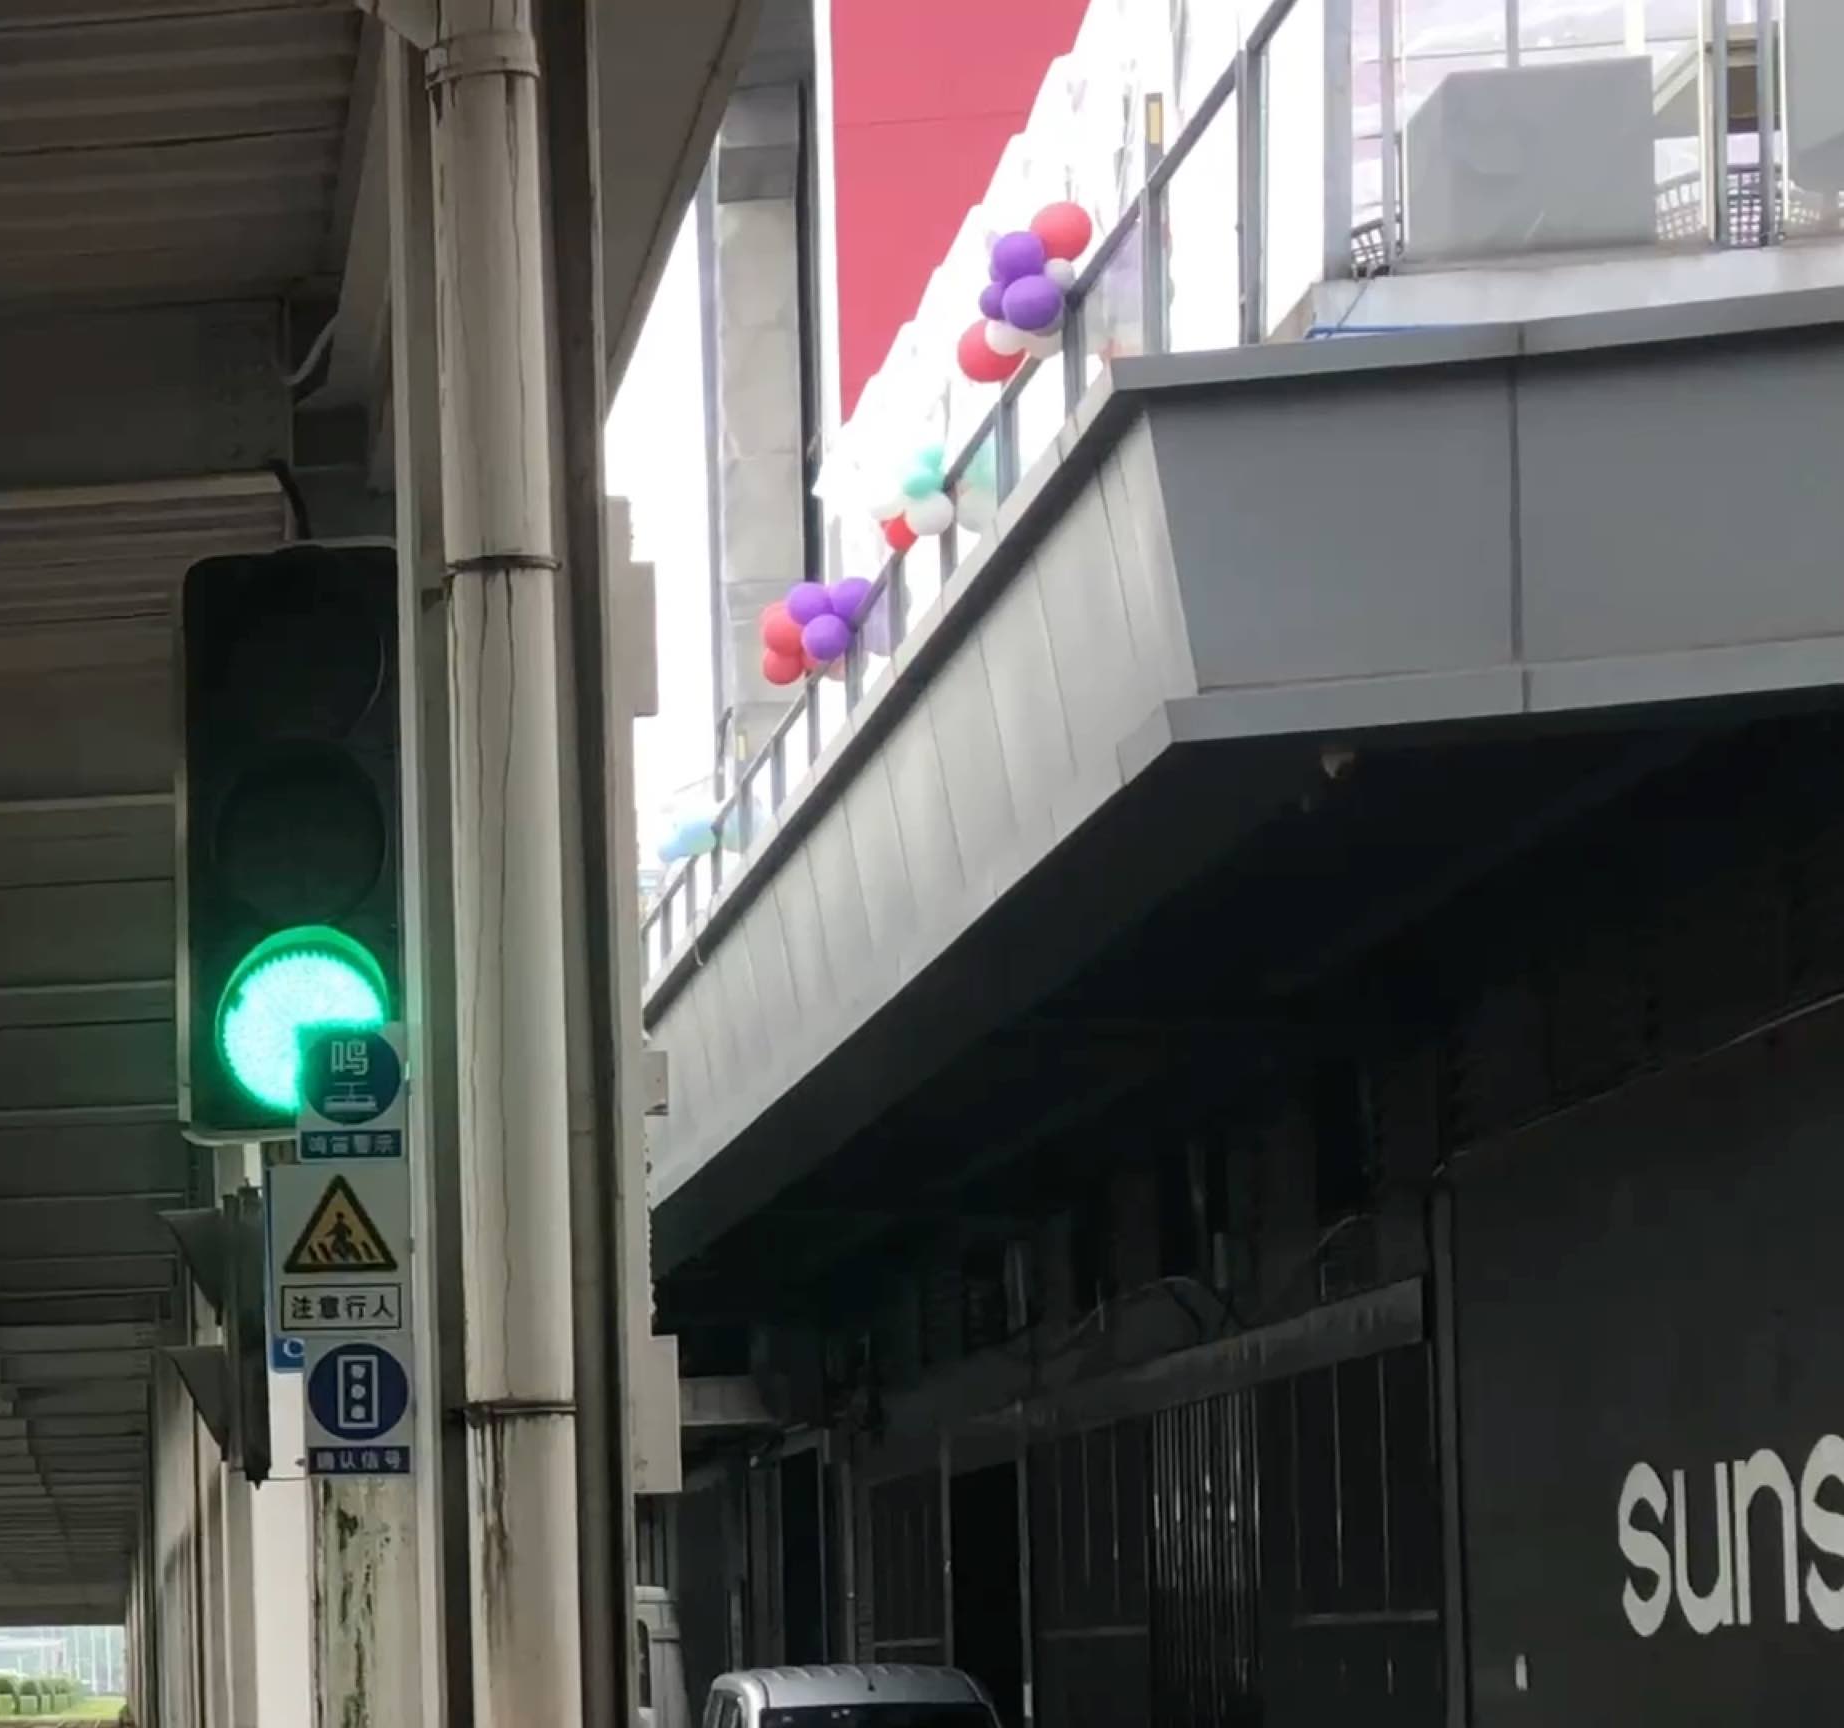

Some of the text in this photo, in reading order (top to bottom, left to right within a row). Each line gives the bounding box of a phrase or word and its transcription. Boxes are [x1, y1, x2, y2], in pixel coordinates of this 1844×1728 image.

[330, 1038, 370, 1076] 鸣
[291, 1294, 394, 1321] 注意行人
